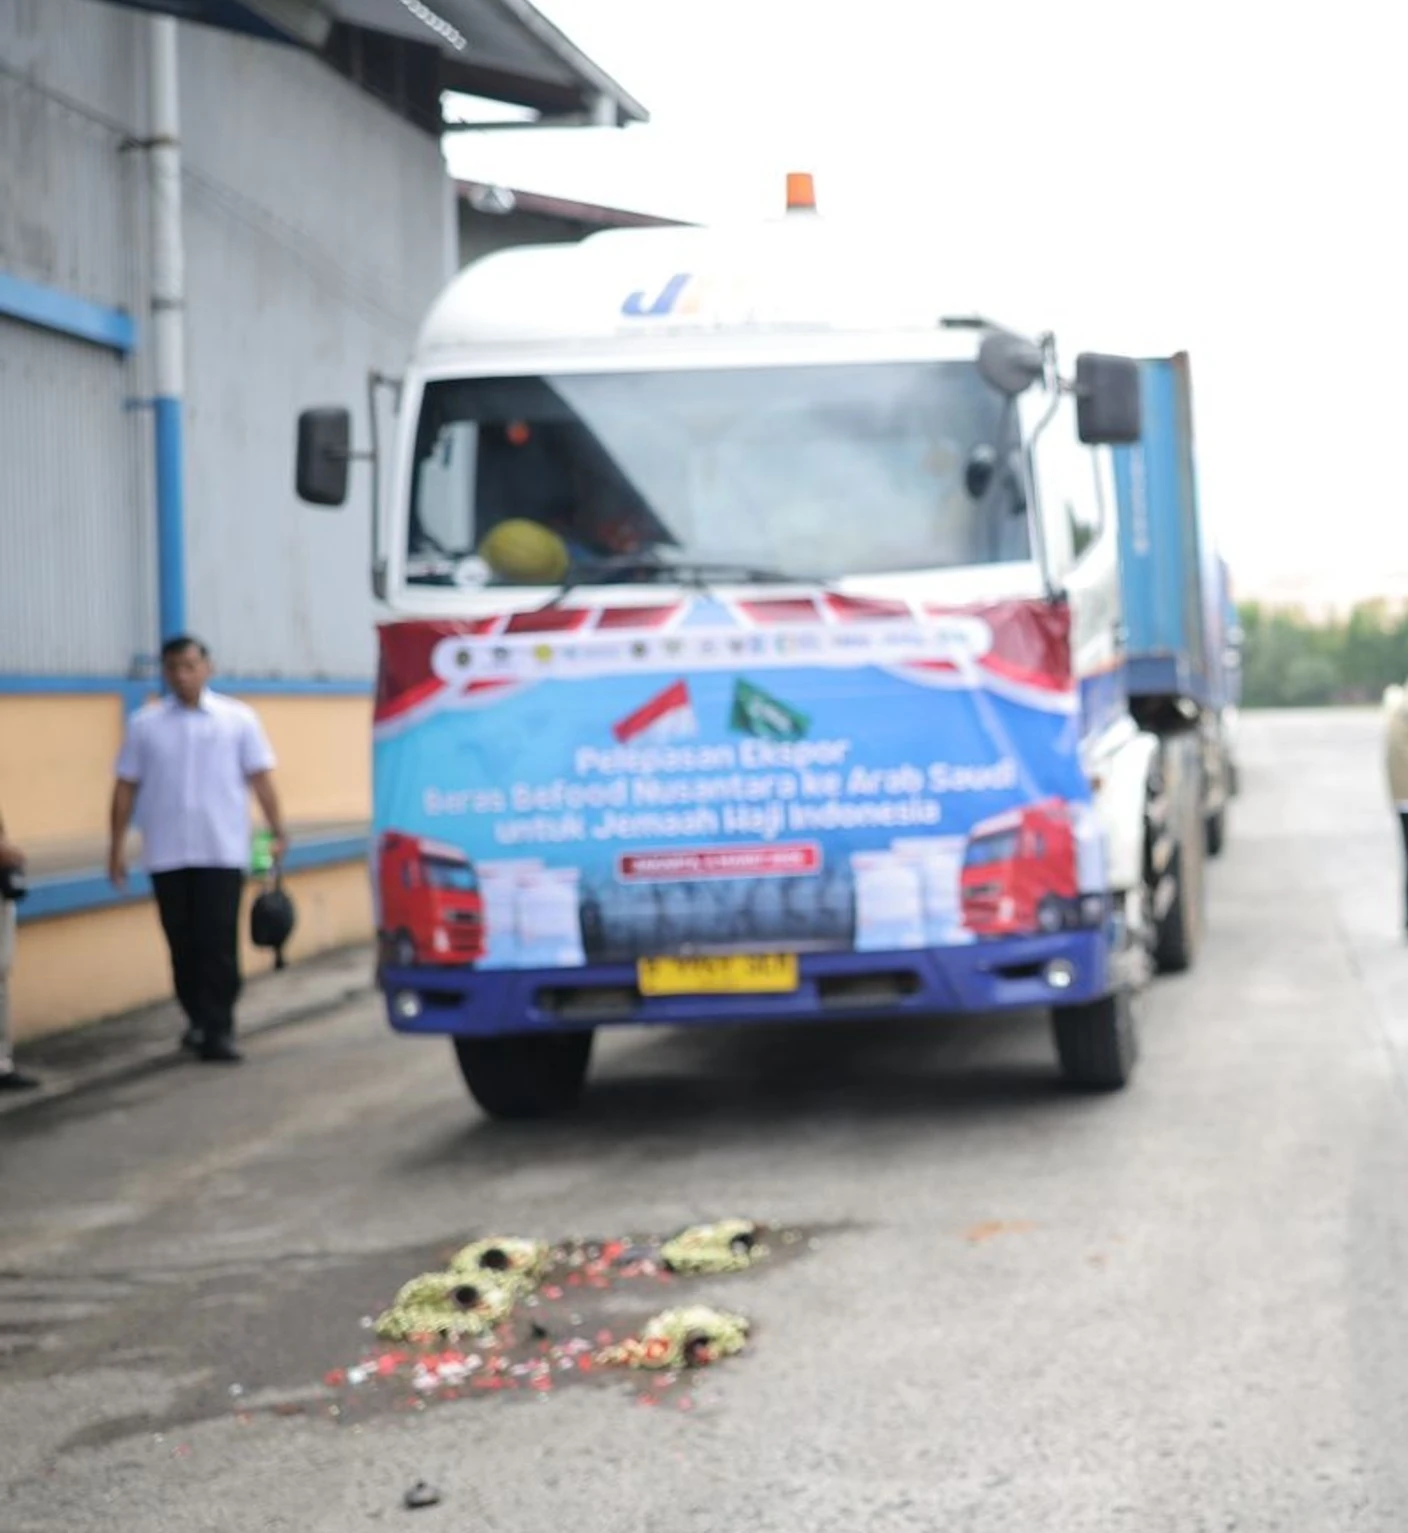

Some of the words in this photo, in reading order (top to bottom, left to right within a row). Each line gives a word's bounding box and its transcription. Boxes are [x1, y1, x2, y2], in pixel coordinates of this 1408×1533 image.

[576, 745, 735, 776] Pelepasan
[741, 739, 848, 771] Ekspor
[634, 772, 796, 805] Nusantara
[802, 770, 842, 797] ke
[847, 767, 923, 795] Arab
[930, 757, 1017, 791] Saudi
[494, 816, 583, 843] untuk
[593, 807, 717, 839] Jemaah
[724, 804, 783, 839] Haji
[791, 798, 940, 831] Indonesia
